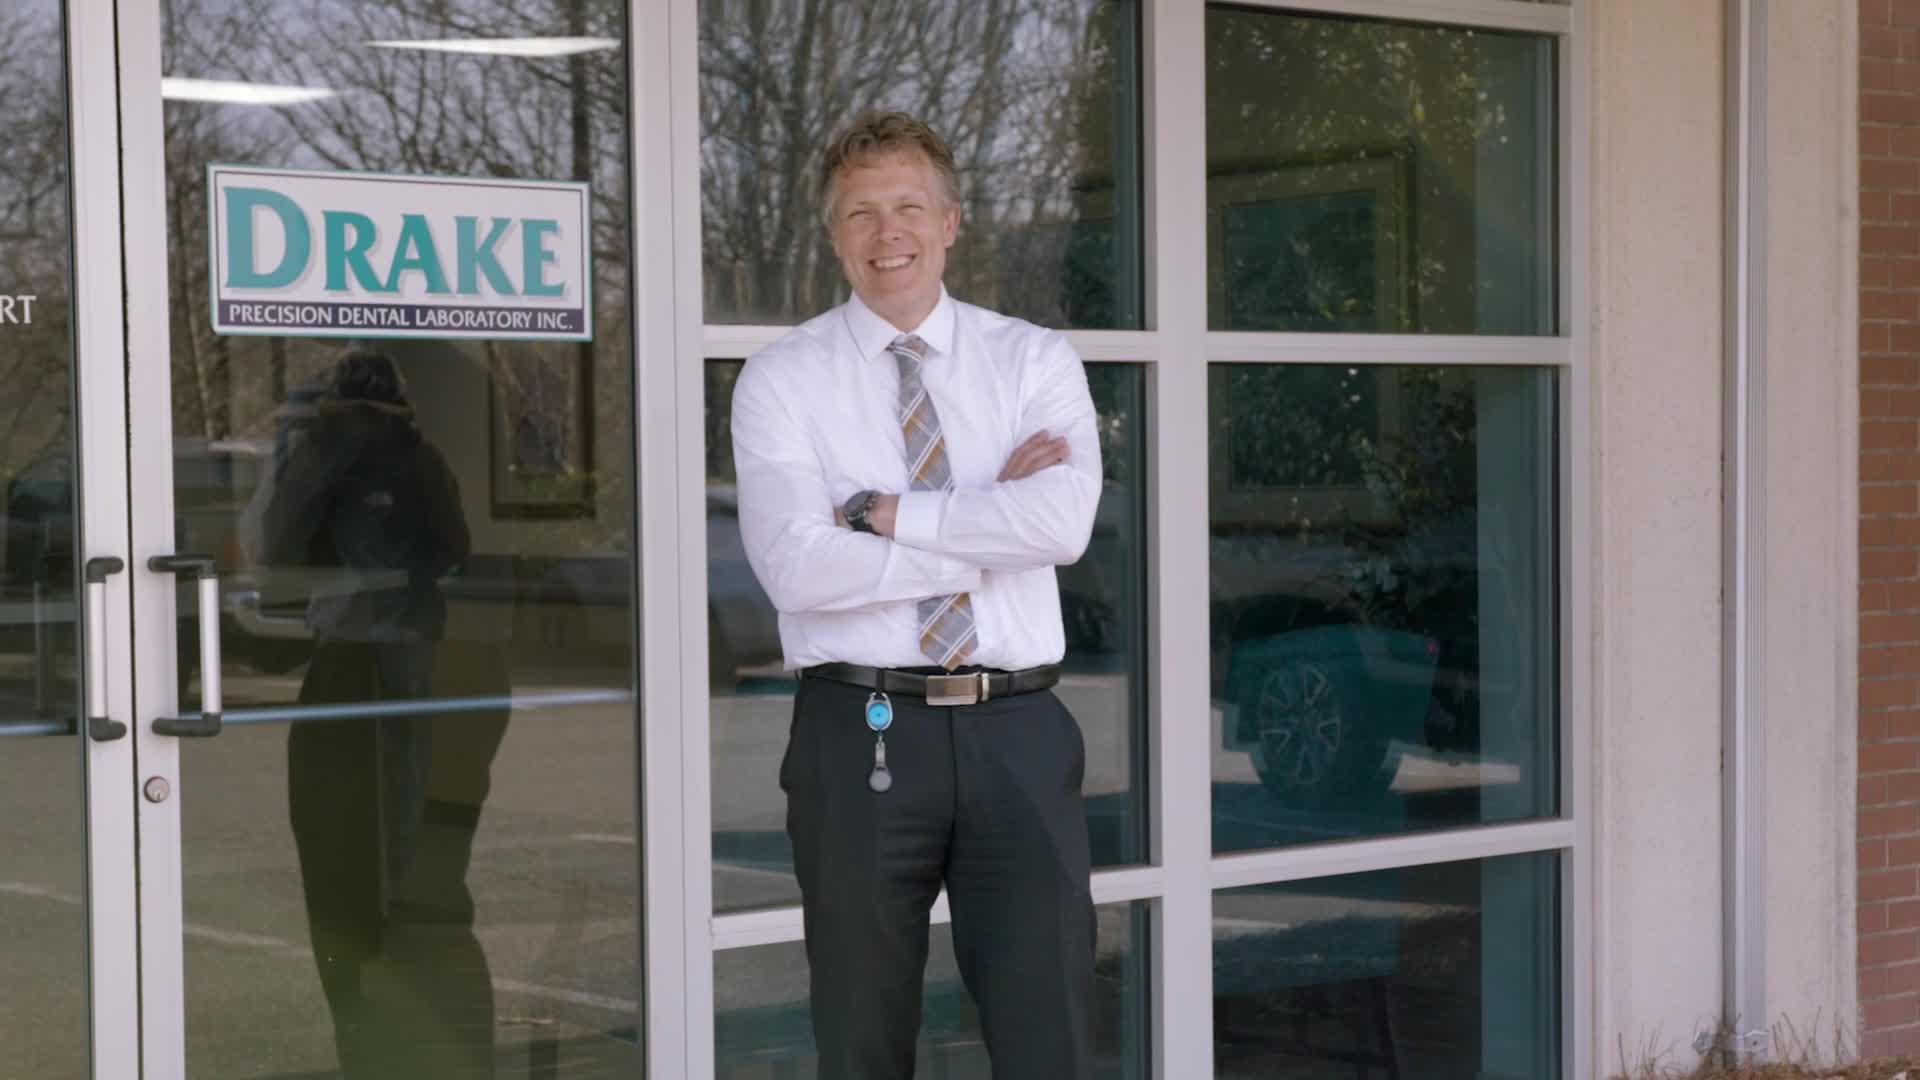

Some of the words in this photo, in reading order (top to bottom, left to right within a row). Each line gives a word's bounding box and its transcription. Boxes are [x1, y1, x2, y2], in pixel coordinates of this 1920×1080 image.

[223, 186, 567, 298] DRAKE
[229, 304, 332, 325] PRECISION
[338, 306, 410, 326] DENTAL
[415, 308, 532, 329] LABORATORY
[538, 311, 573, 329] INC.
